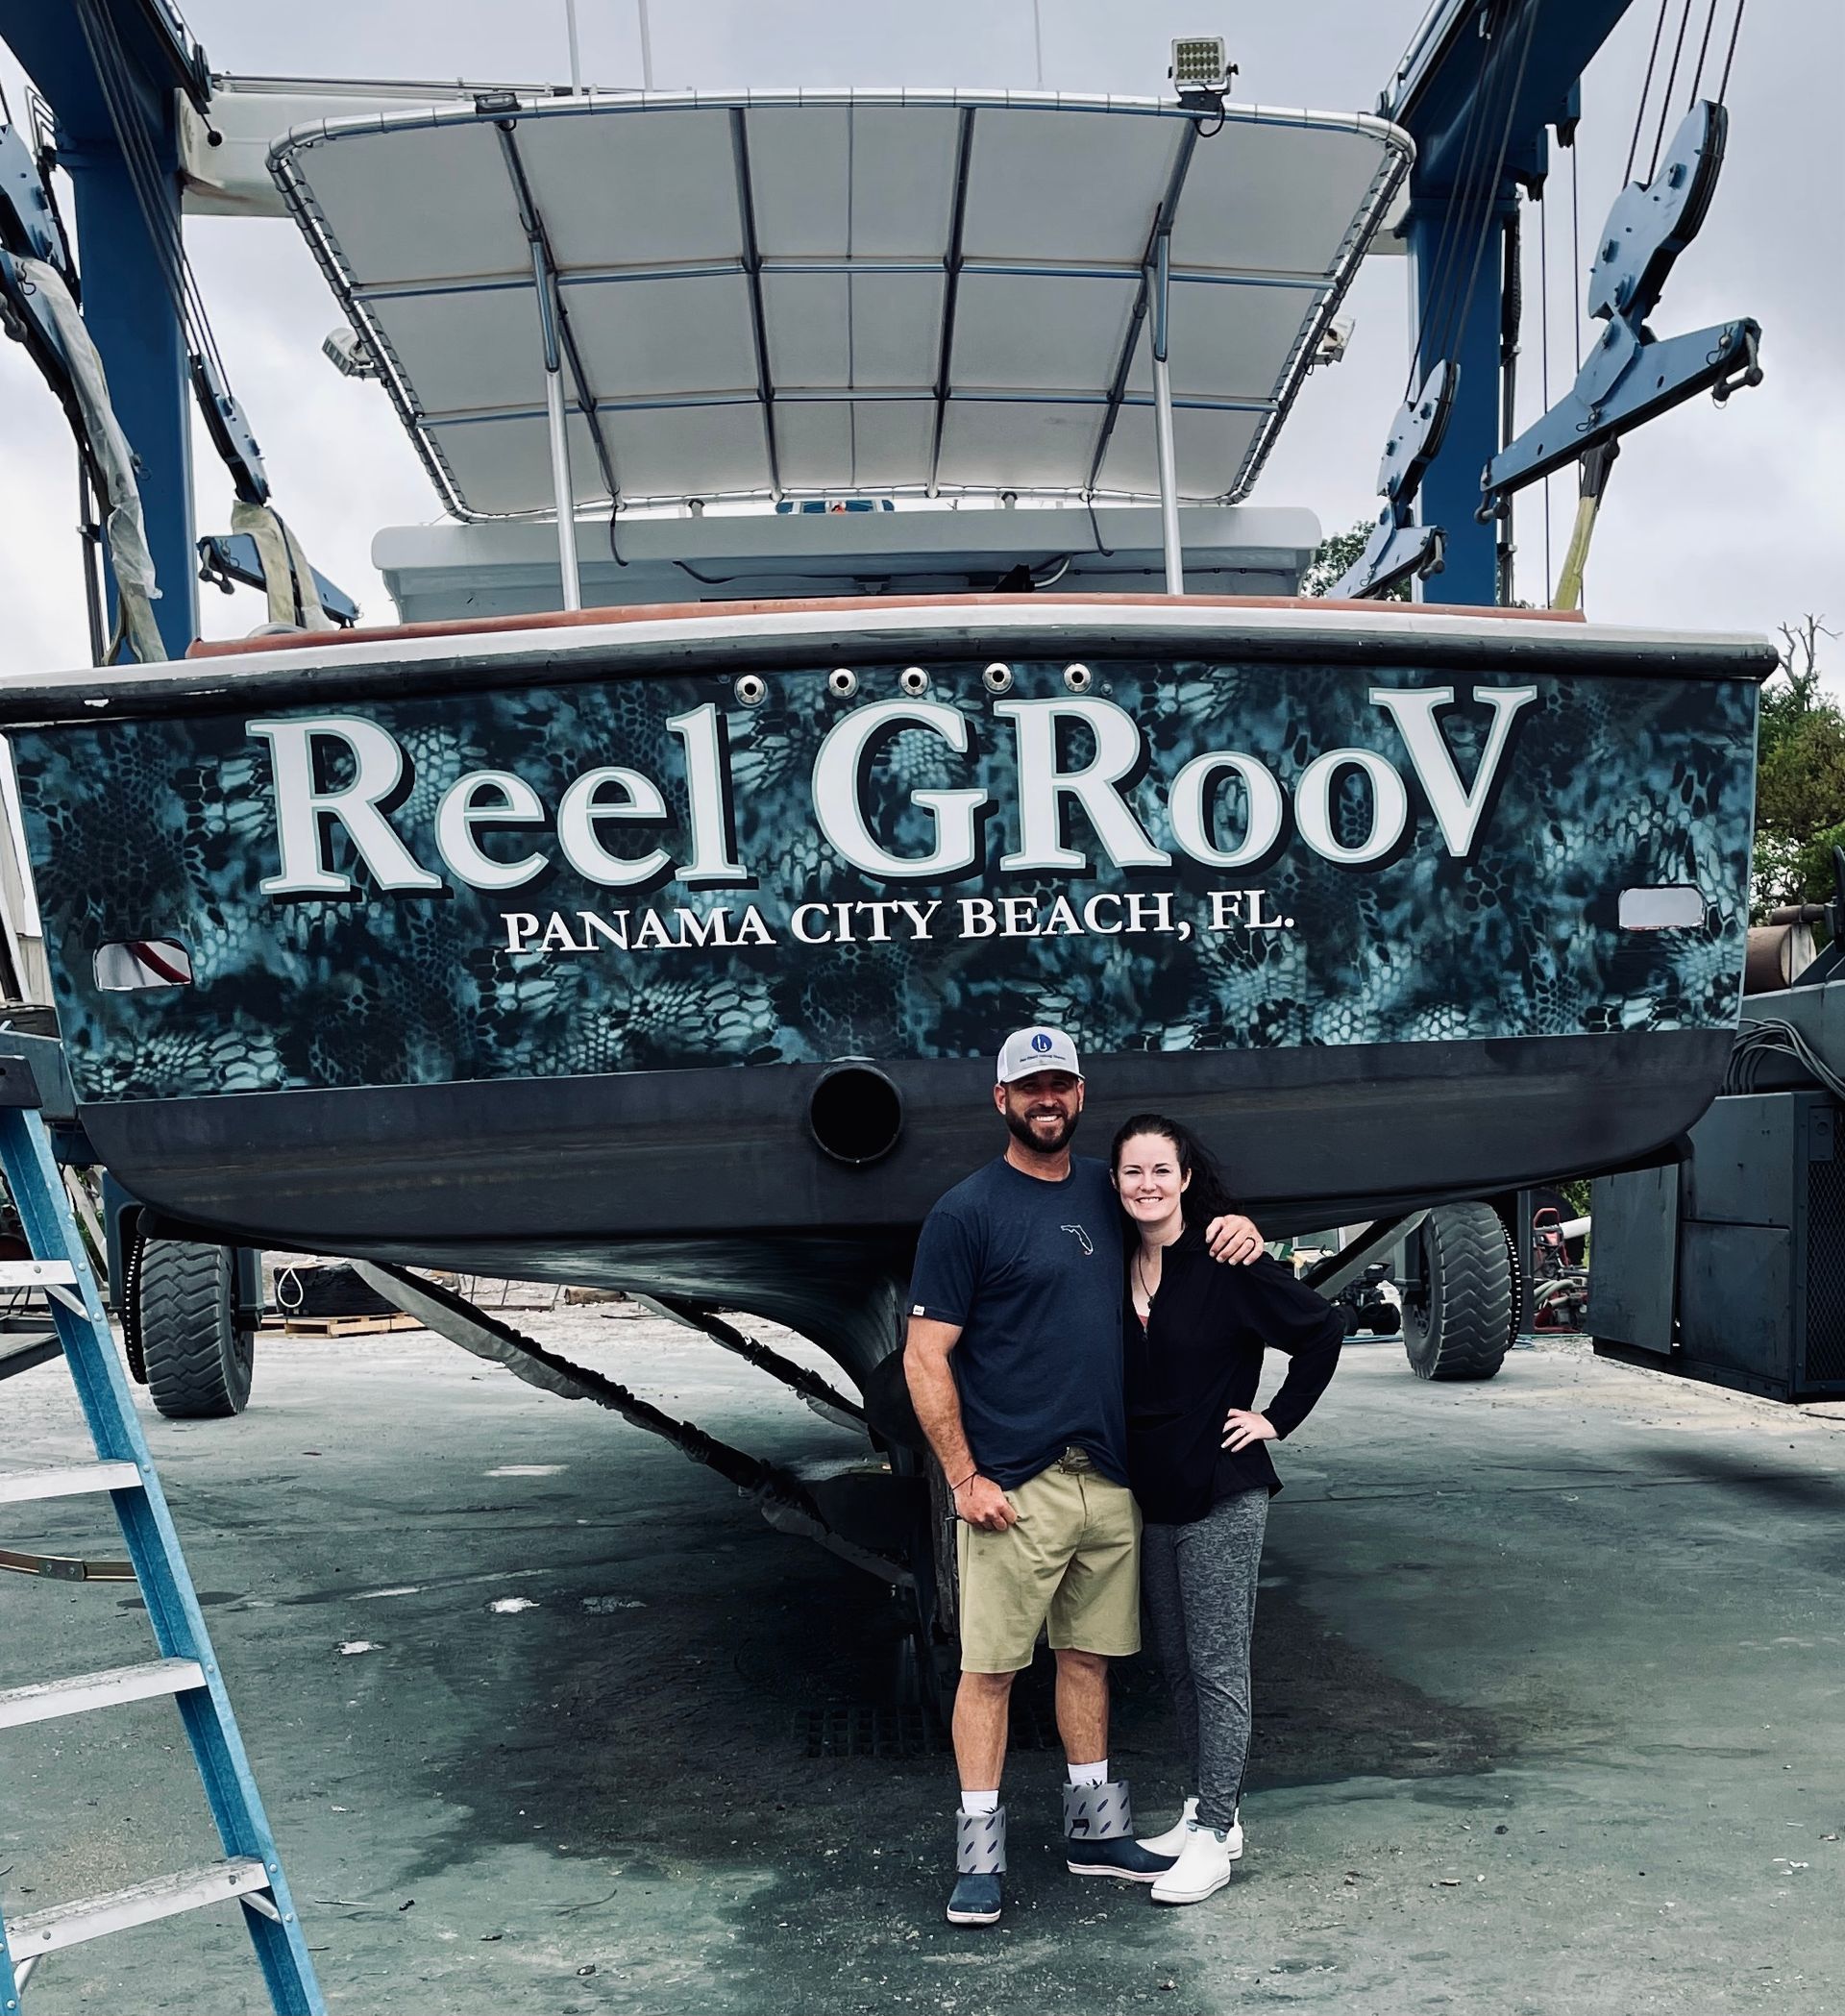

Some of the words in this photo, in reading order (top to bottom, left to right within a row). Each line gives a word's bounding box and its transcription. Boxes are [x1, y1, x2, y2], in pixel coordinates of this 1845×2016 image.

[245, 701, 748, 896] Reel
[811, 684, 1539, 878] GRooV
[500, 905, 777, 953] PANAMA
[791, 899, 943, 944] CITY
[956, 892, 1192, 942] BEACH,
[1206, 889, 1296, 930] FL.
